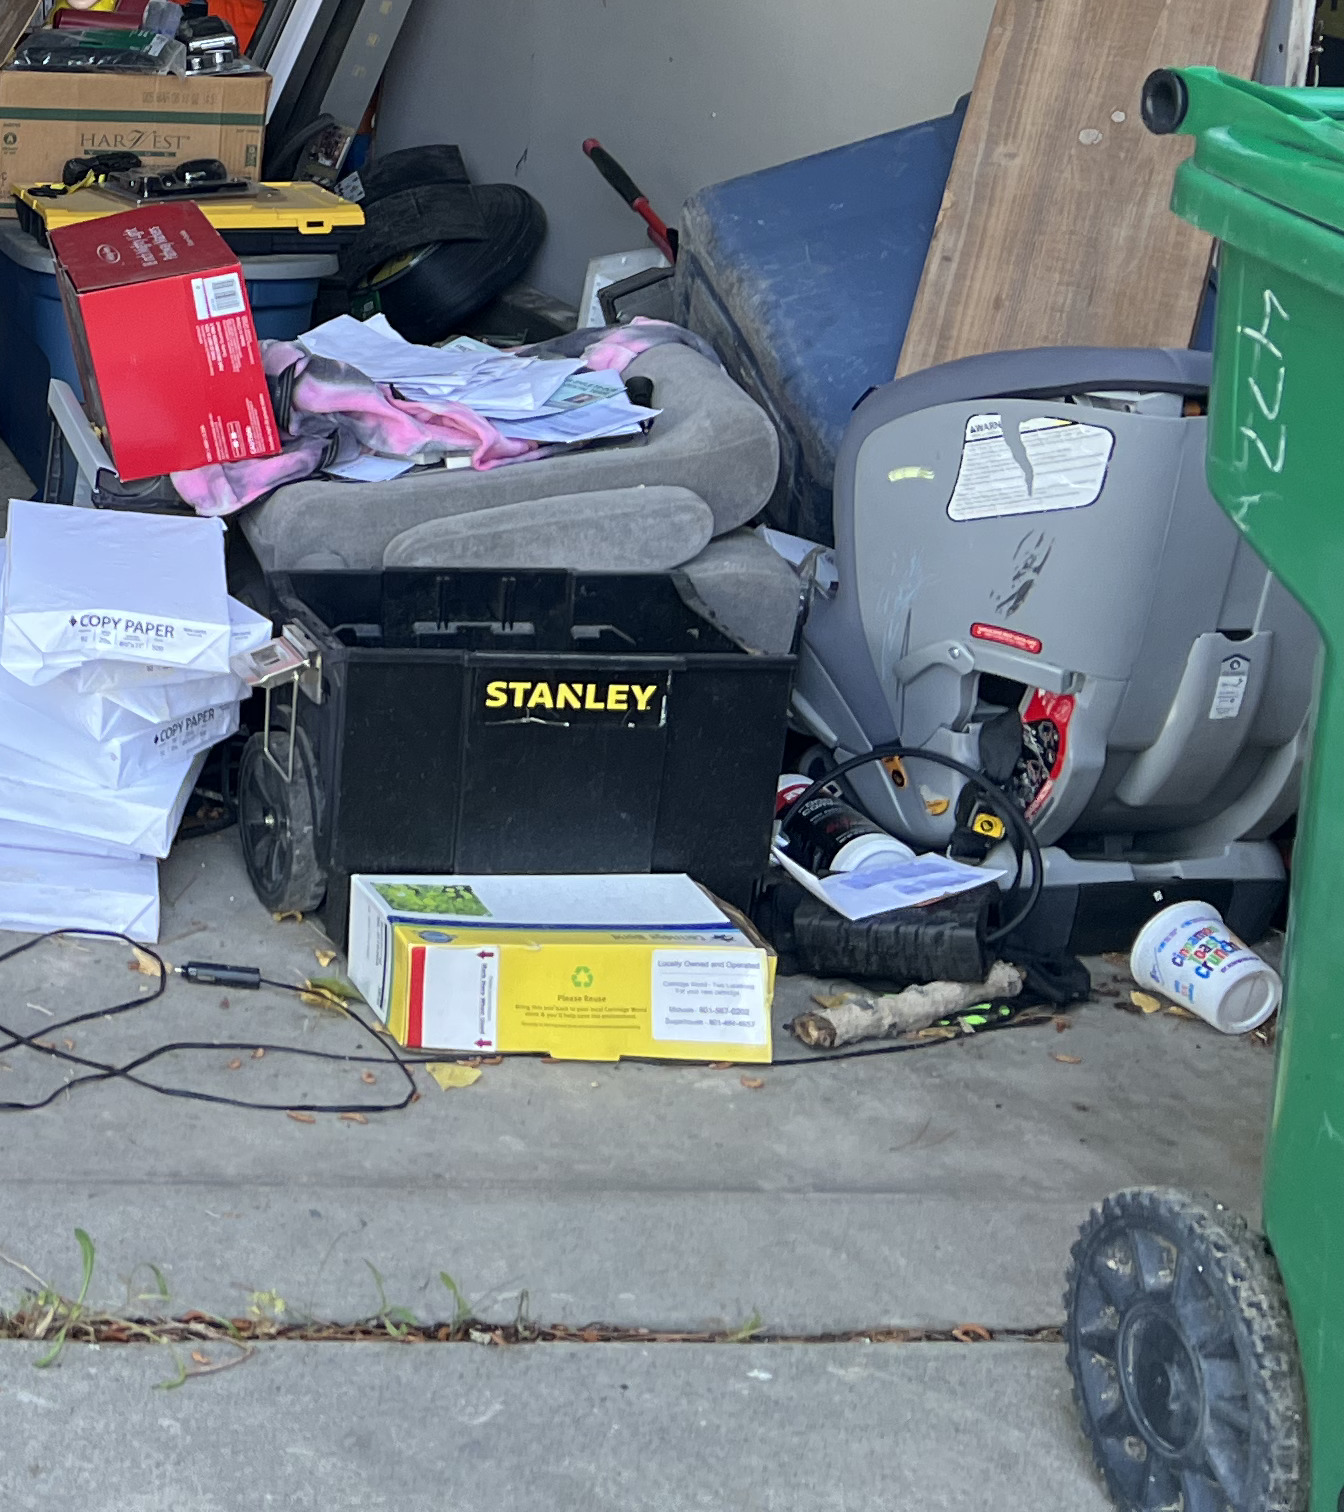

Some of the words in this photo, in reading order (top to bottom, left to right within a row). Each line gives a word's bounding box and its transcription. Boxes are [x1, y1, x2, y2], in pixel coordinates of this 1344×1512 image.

[79, 614, 122, 630] COPY
[124, 619, 175, 639] PAPER
[484, 680, 657, 712] STANLEY
[159, 720, 184, 743] COPY
[185, 707, 215, 731] PAPER
[657, 960, 682, 969] Locally
[683, 960, 709, 968] Owned
[726, 961, 760, 970] Operated
[557, 994, 582, 1003] Please
[583, 995, 607, 1003] Reuse
